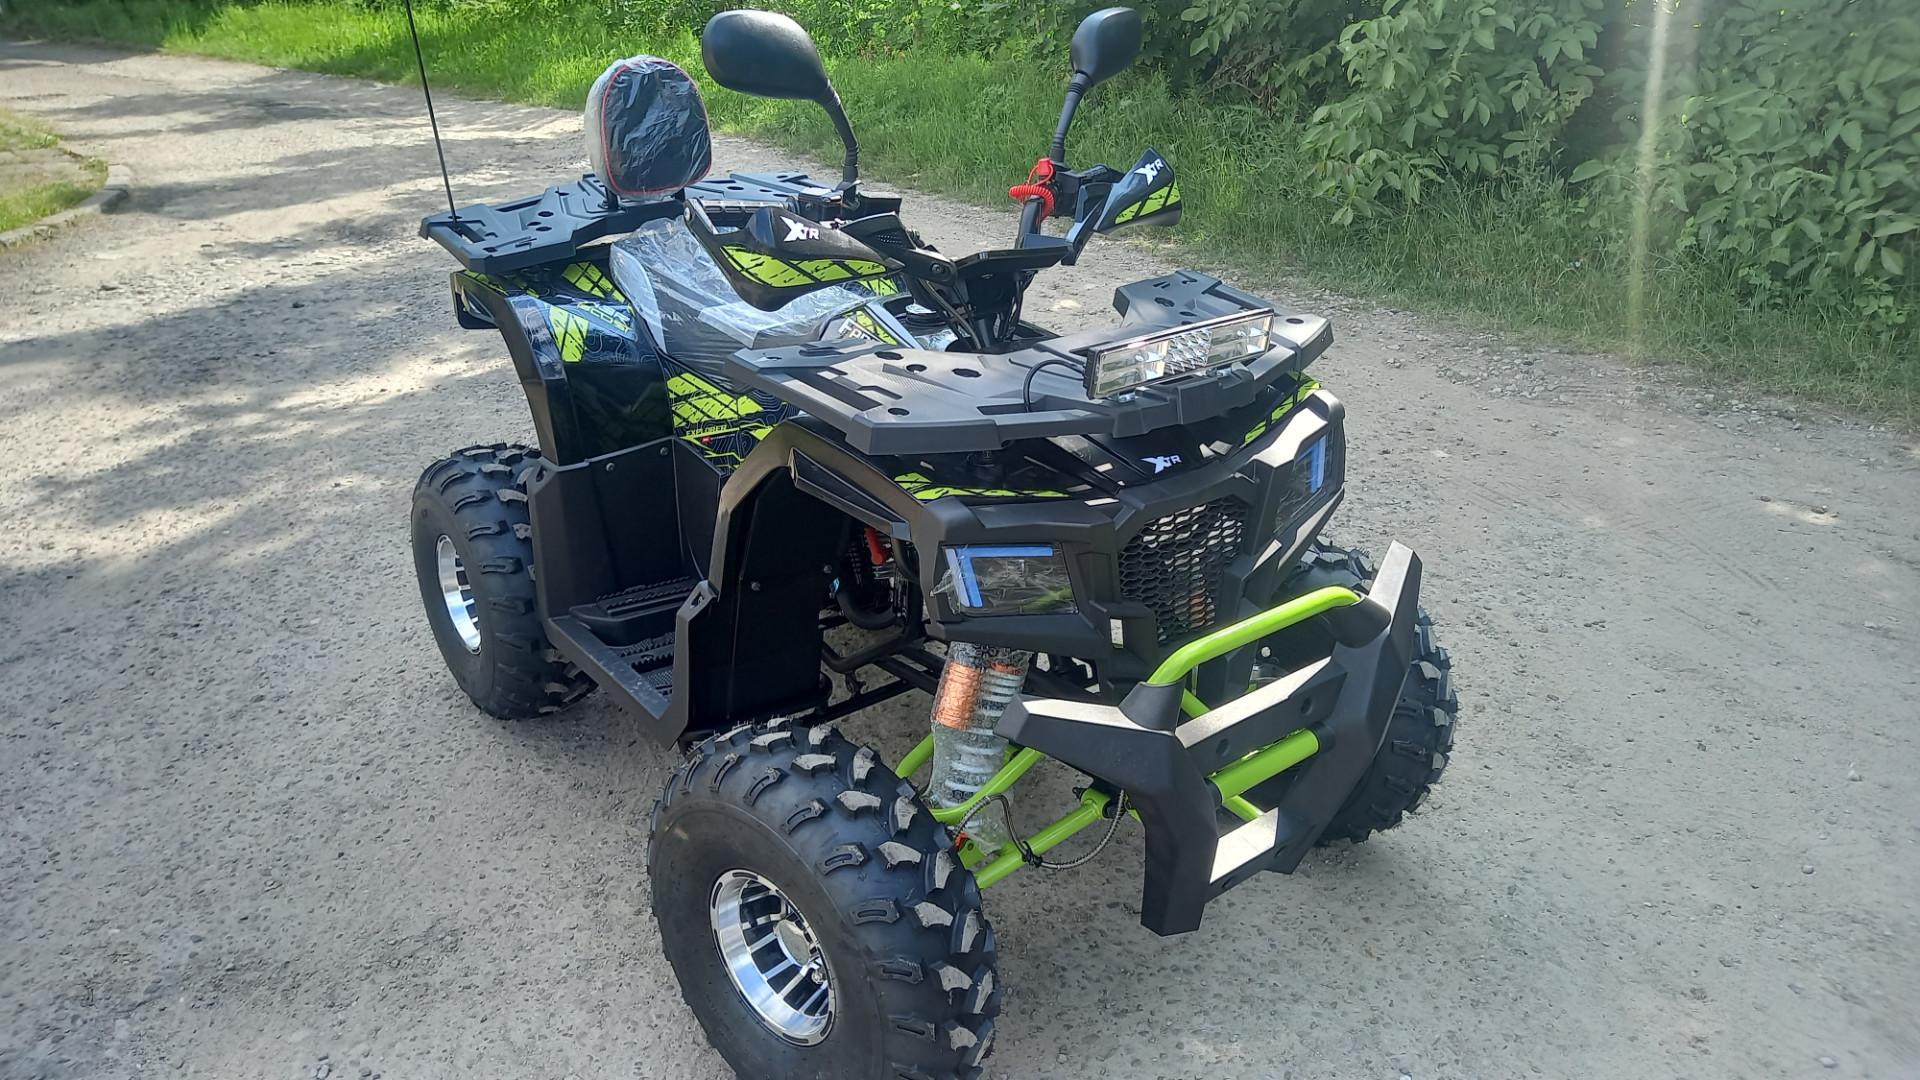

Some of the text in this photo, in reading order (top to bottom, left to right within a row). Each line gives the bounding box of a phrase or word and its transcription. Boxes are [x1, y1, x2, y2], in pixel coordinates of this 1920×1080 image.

[1134, 158, 1164, 185] XTR
[780, 216, 819, 242] XTR
[686, 425, 727, 437] EXPLORER
[1139, 454, 1182, 474] XTR
